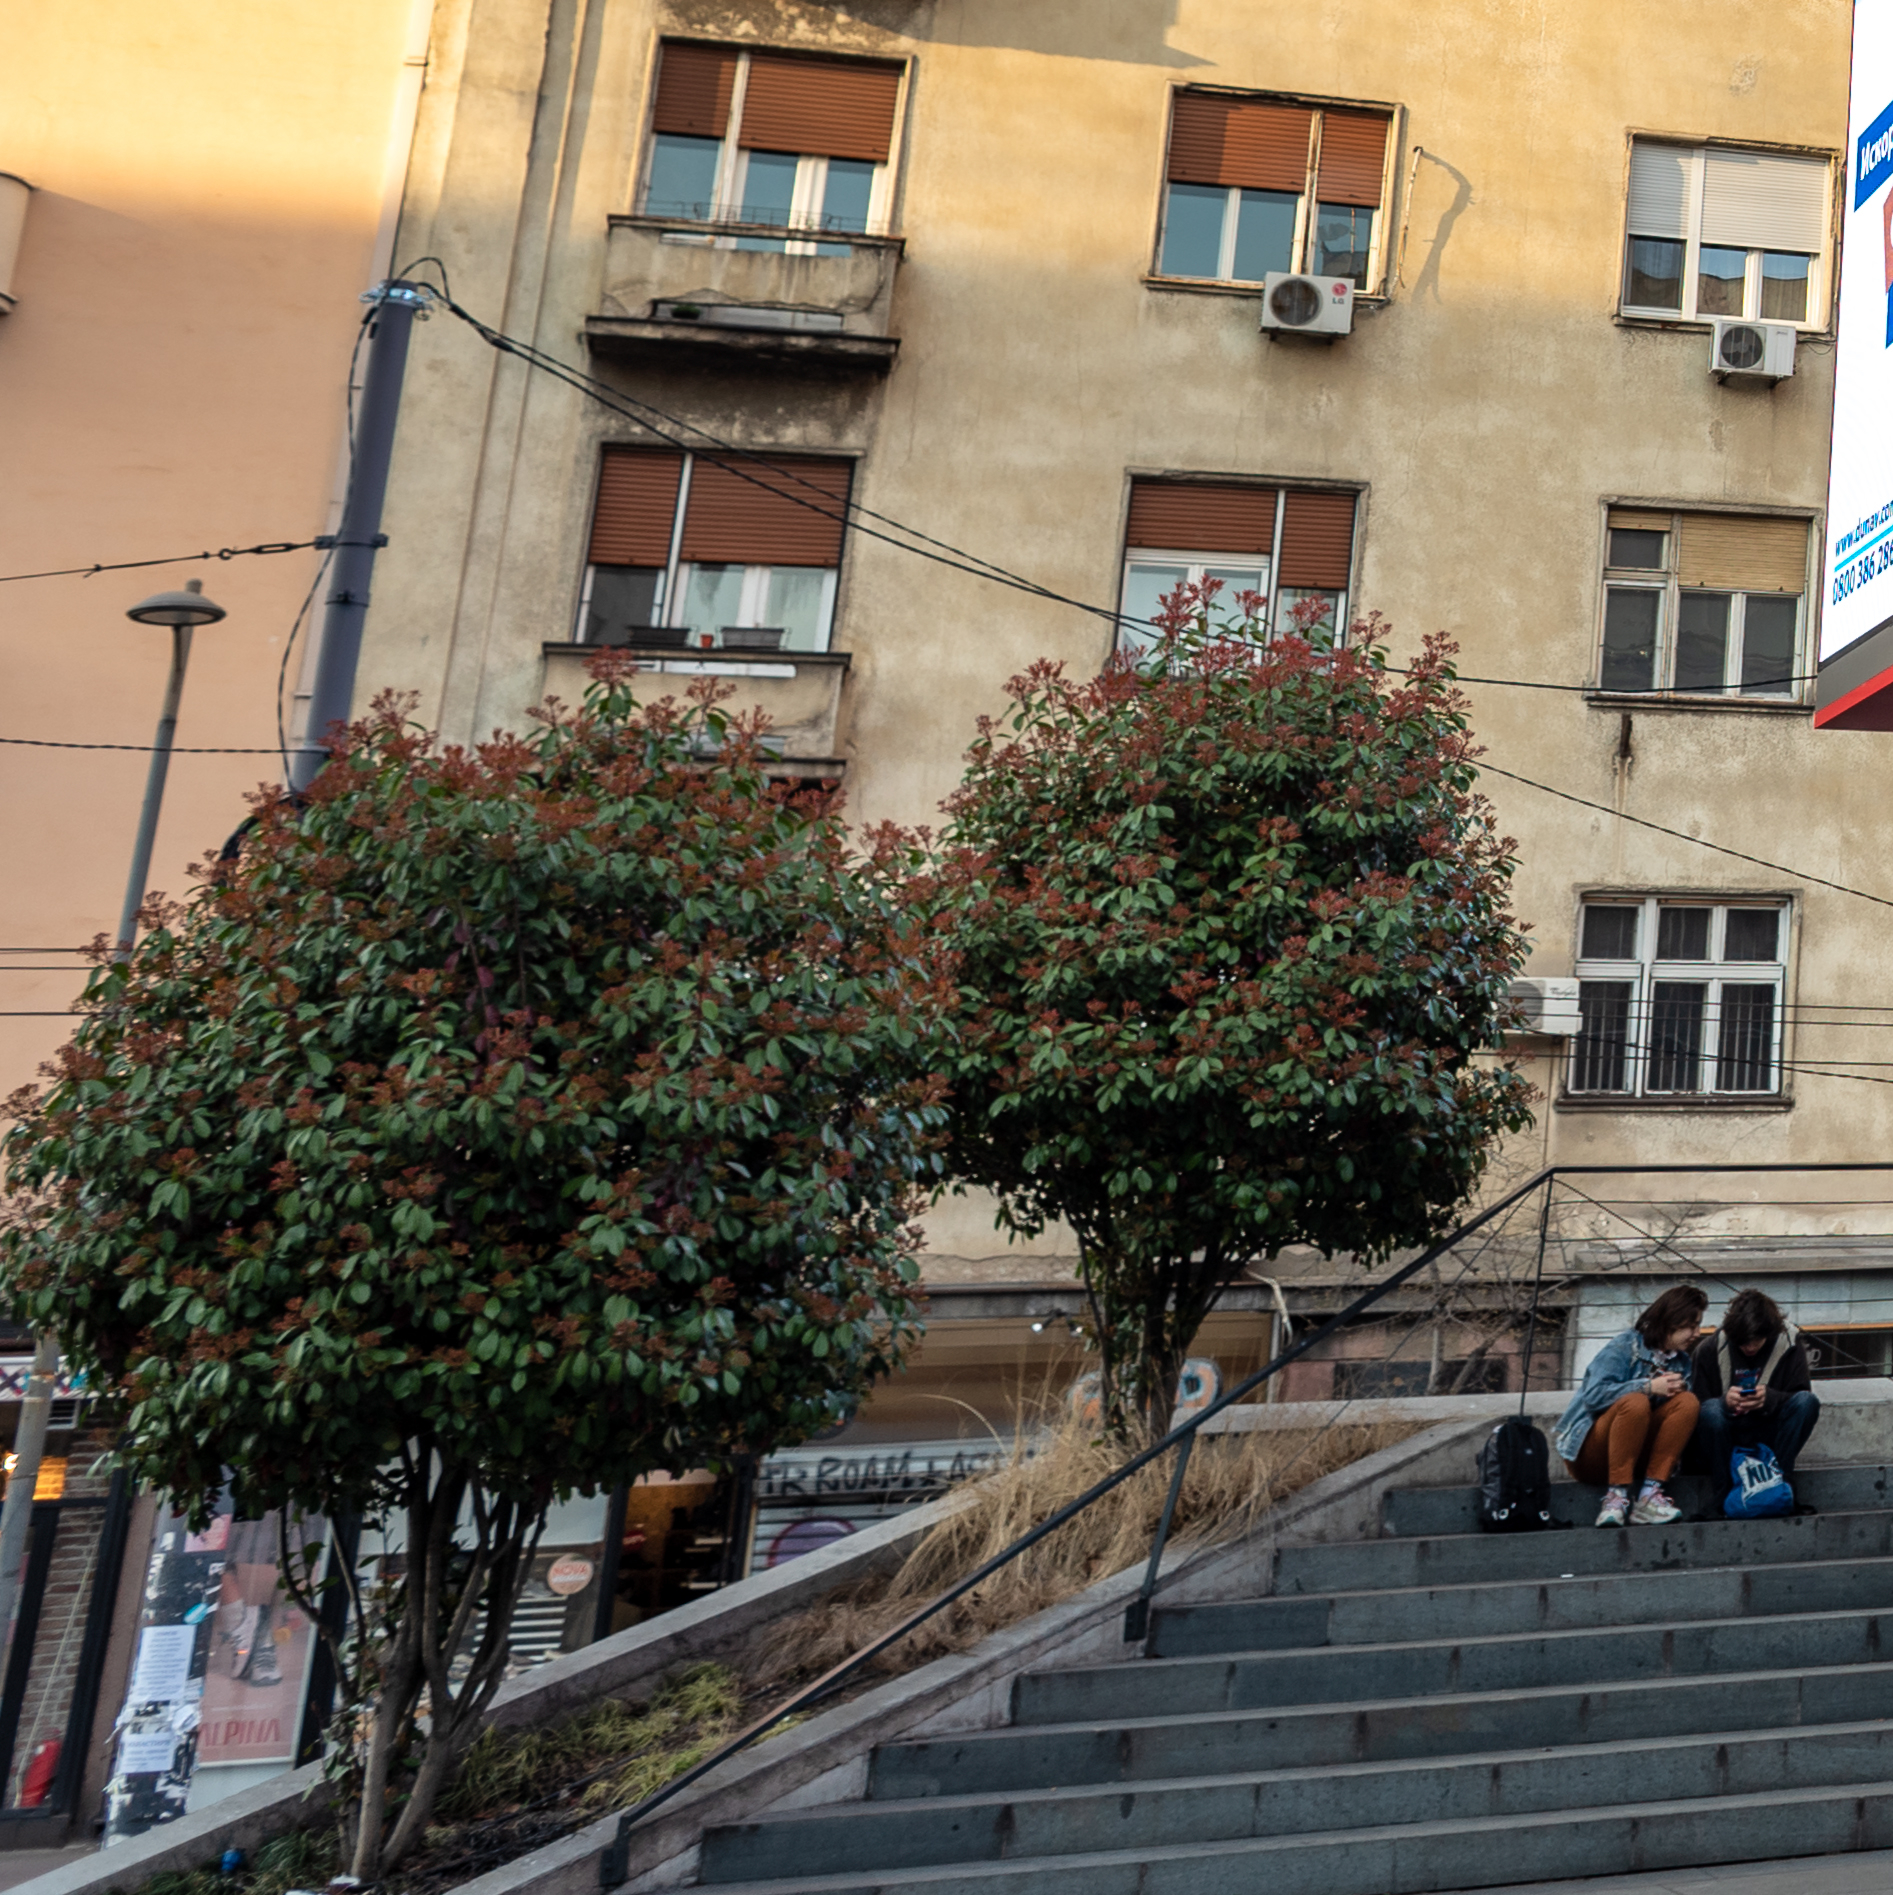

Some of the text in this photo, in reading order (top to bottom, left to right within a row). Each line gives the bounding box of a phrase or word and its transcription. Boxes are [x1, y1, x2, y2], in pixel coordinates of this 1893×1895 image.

[1332, 297, 1344, 305] LG
[1857, 551, 1875, 589] 386
[200, 1717, 281, 1746] ALPINA
